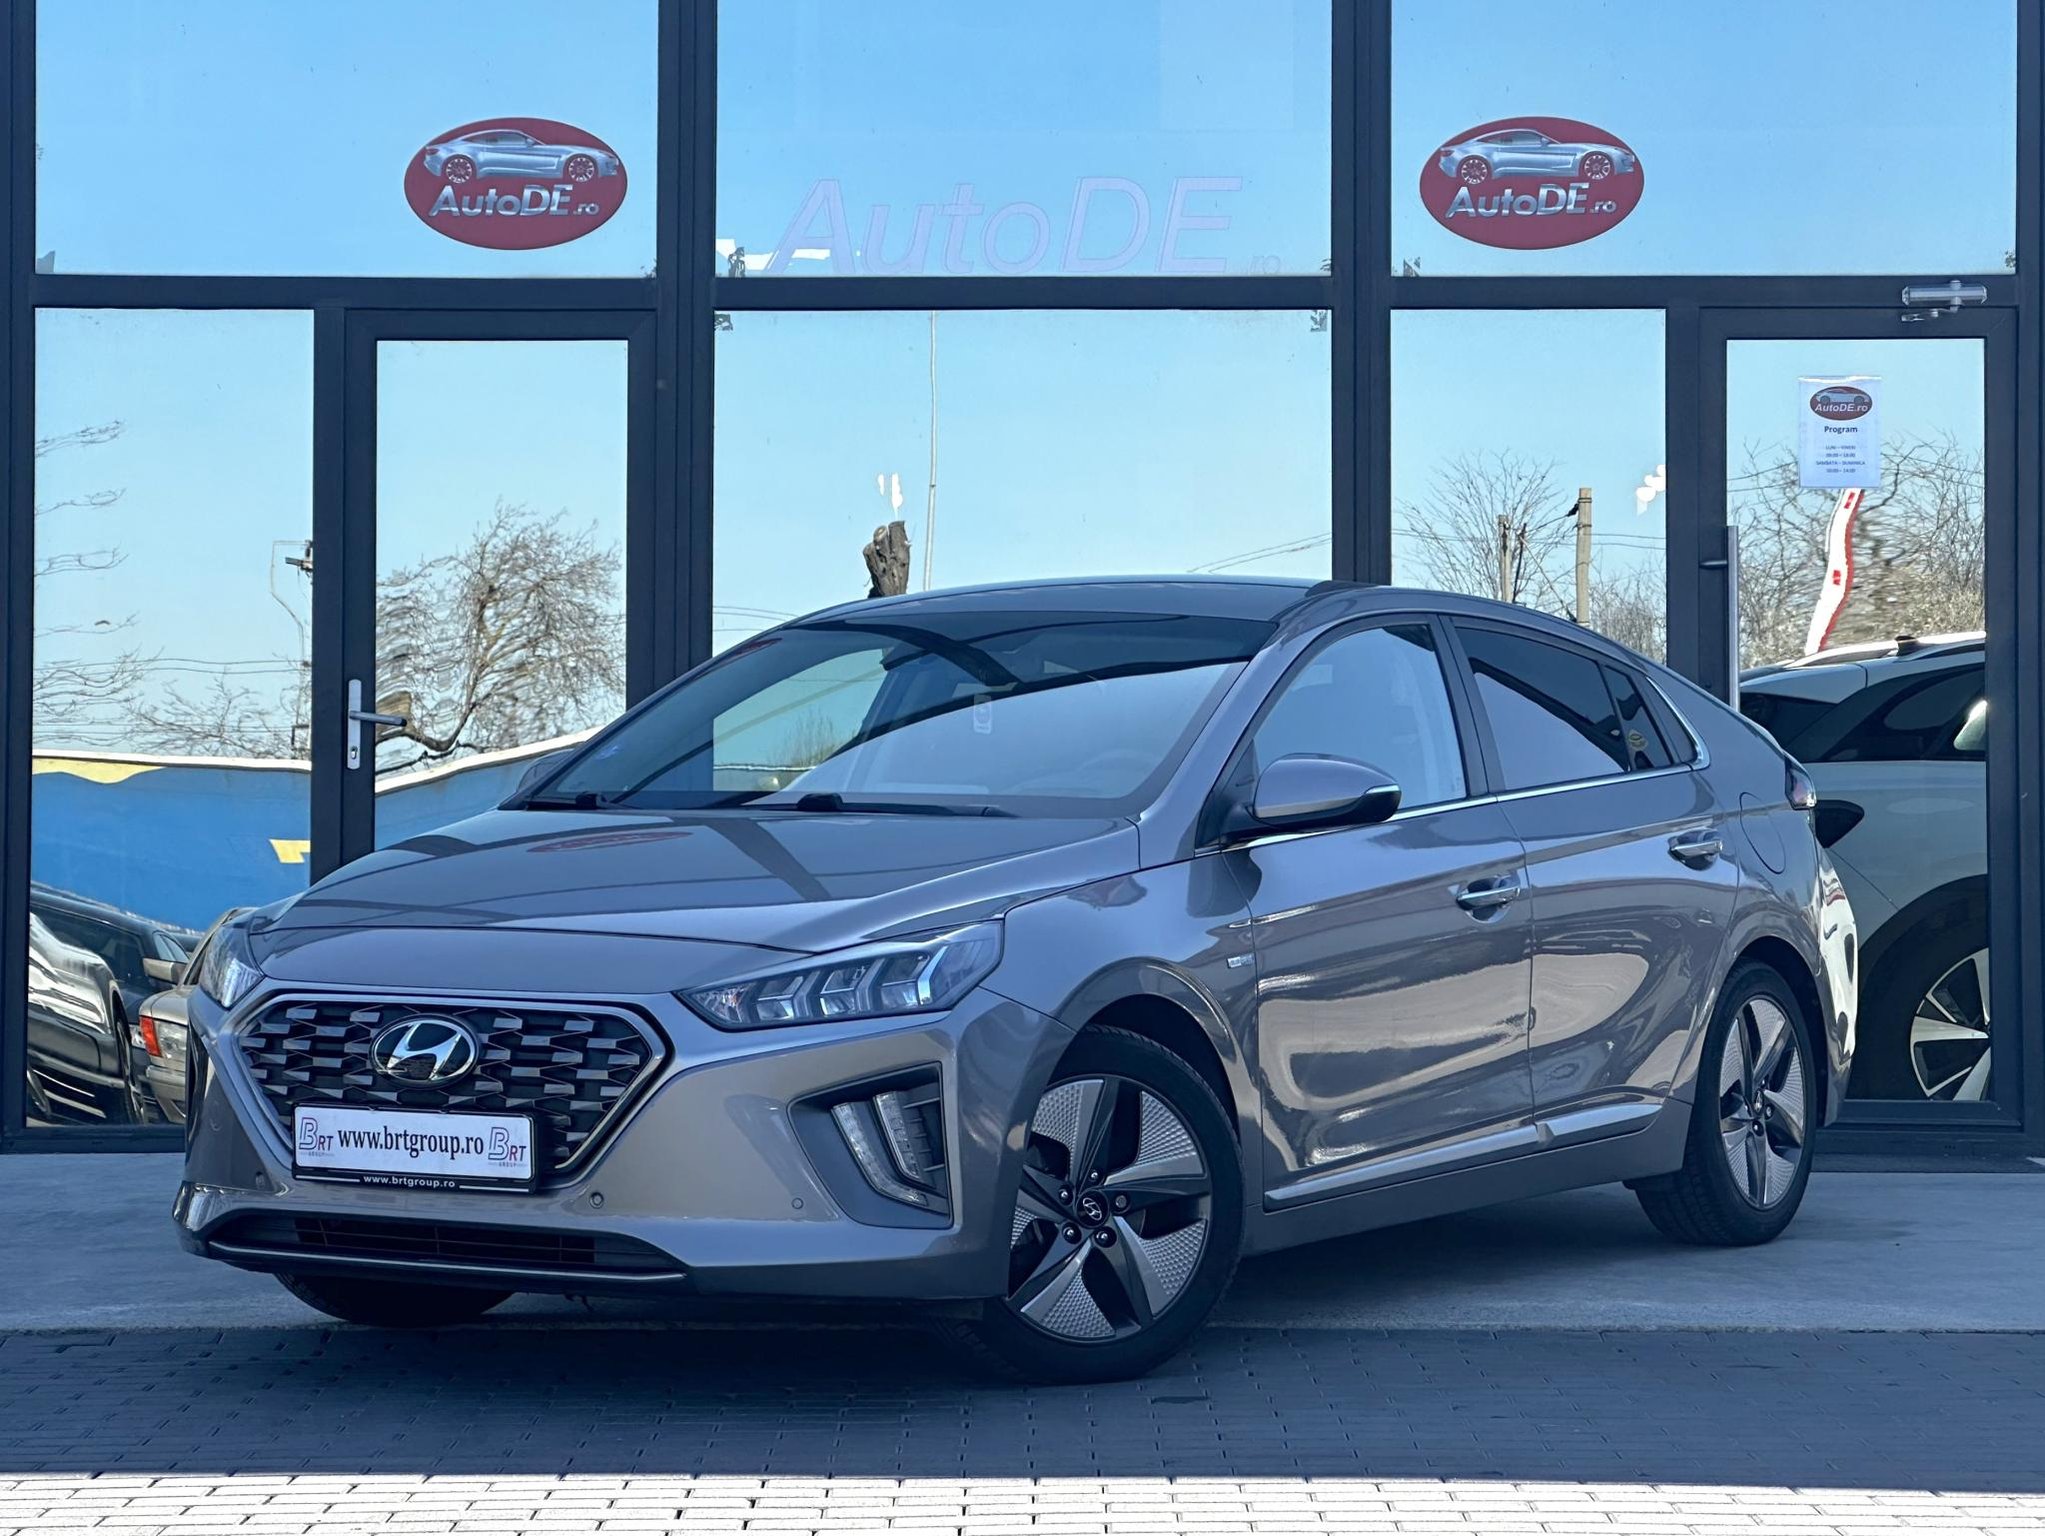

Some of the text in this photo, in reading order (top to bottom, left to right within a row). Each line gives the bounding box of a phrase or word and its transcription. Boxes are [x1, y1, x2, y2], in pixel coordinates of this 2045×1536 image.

[1824, 425, 1858, 435] Program
[299, 1117, 527, 1162] BRT www.brtgroup.ro BRT
[363, 1174, 456, 1189] www.brtgroup.ro
